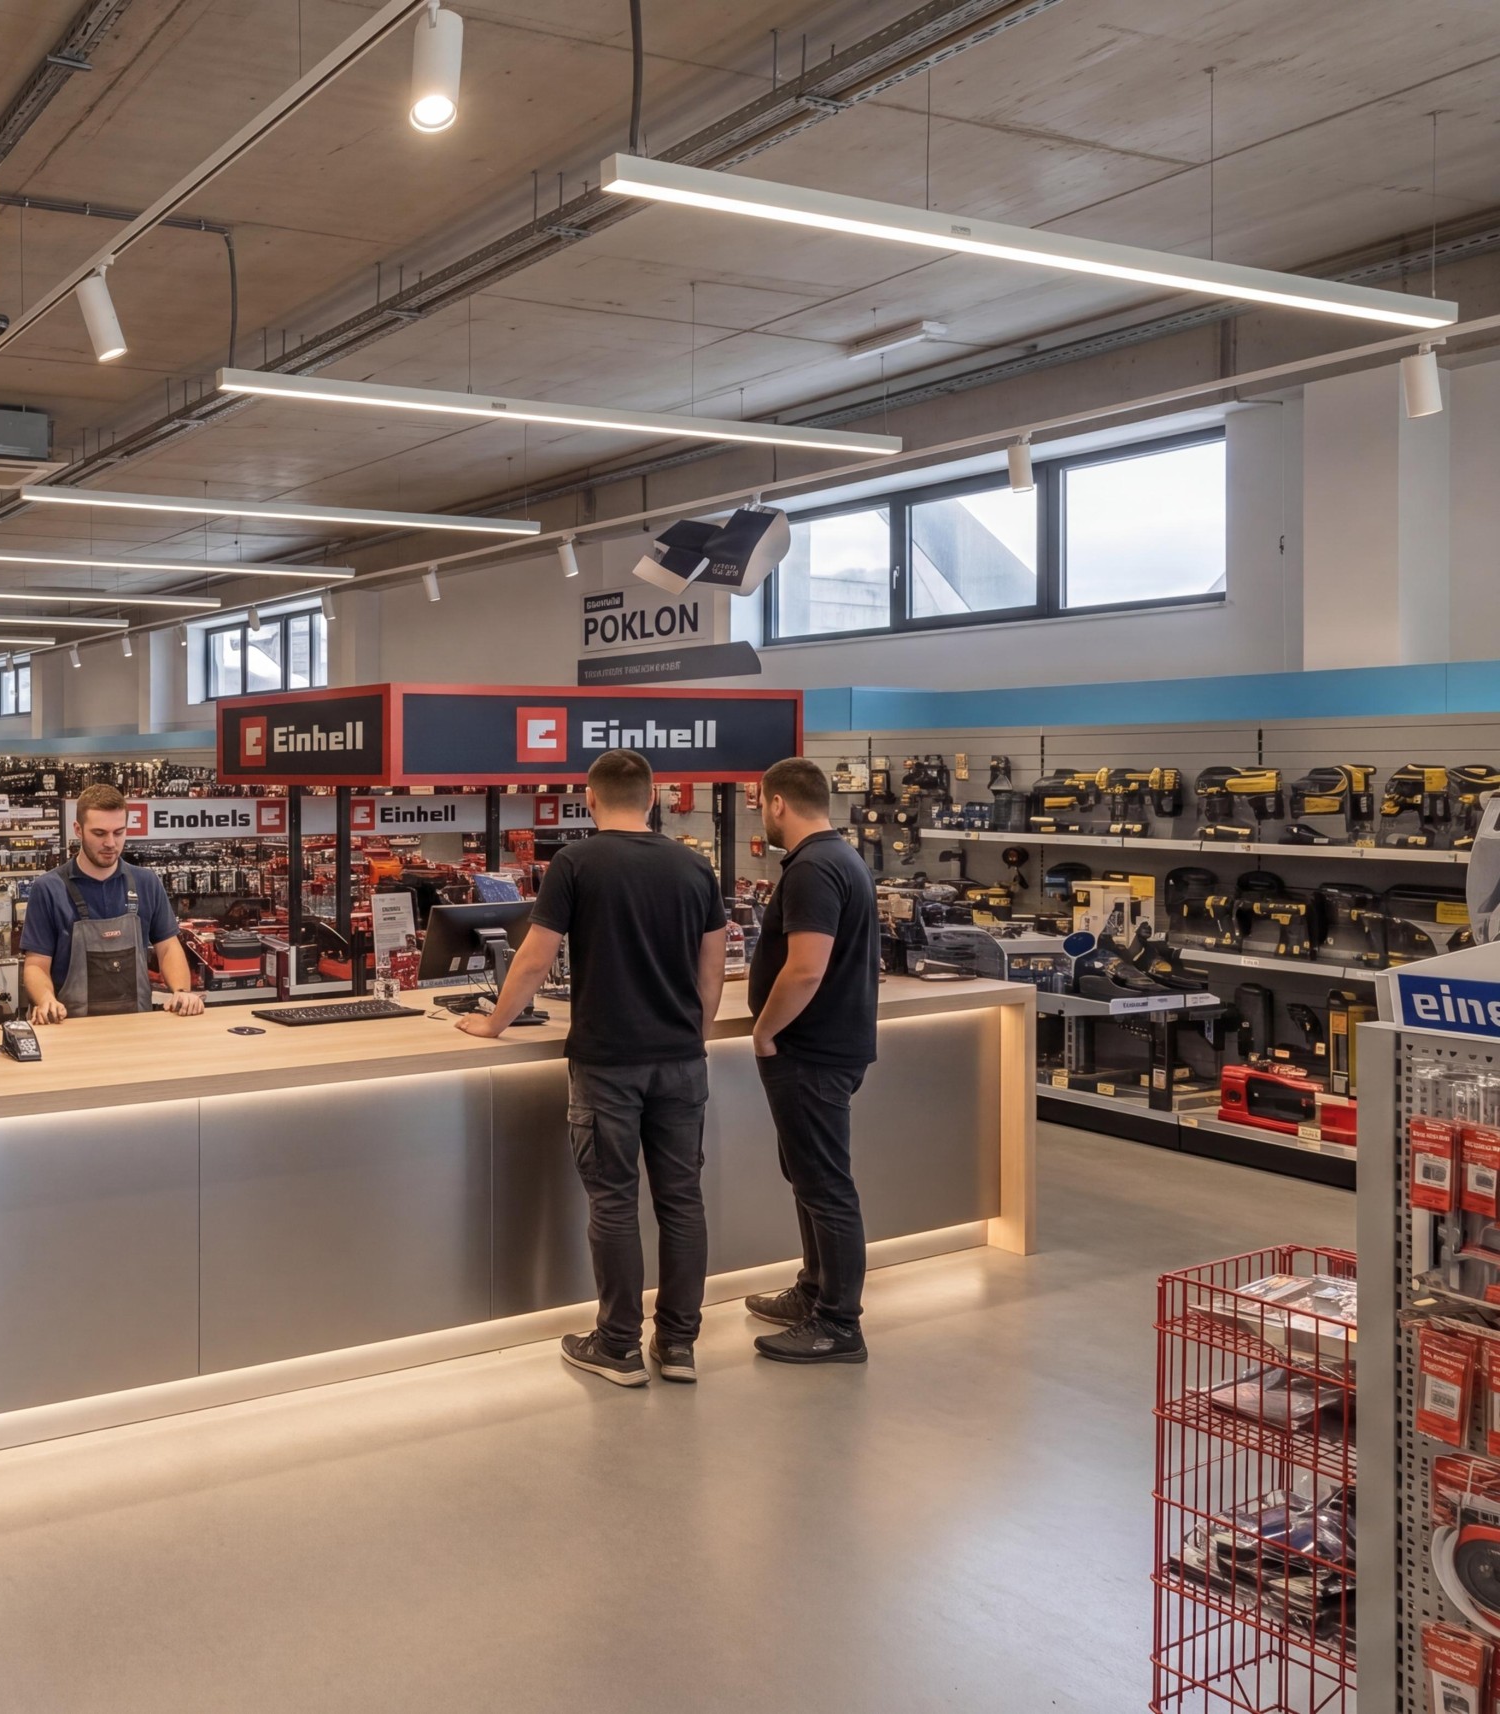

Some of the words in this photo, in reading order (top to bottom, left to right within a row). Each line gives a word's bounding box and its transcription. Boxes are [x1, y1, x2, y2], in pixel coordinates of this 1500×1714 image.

[584, 602, 698, 646] POKLON
[273, 721, 363, 752] Einhell
[582, 720, 716, 748] Einhell
[153, 809, 250, 828] Enohels
[380, 805, 456, 823] Einhell
